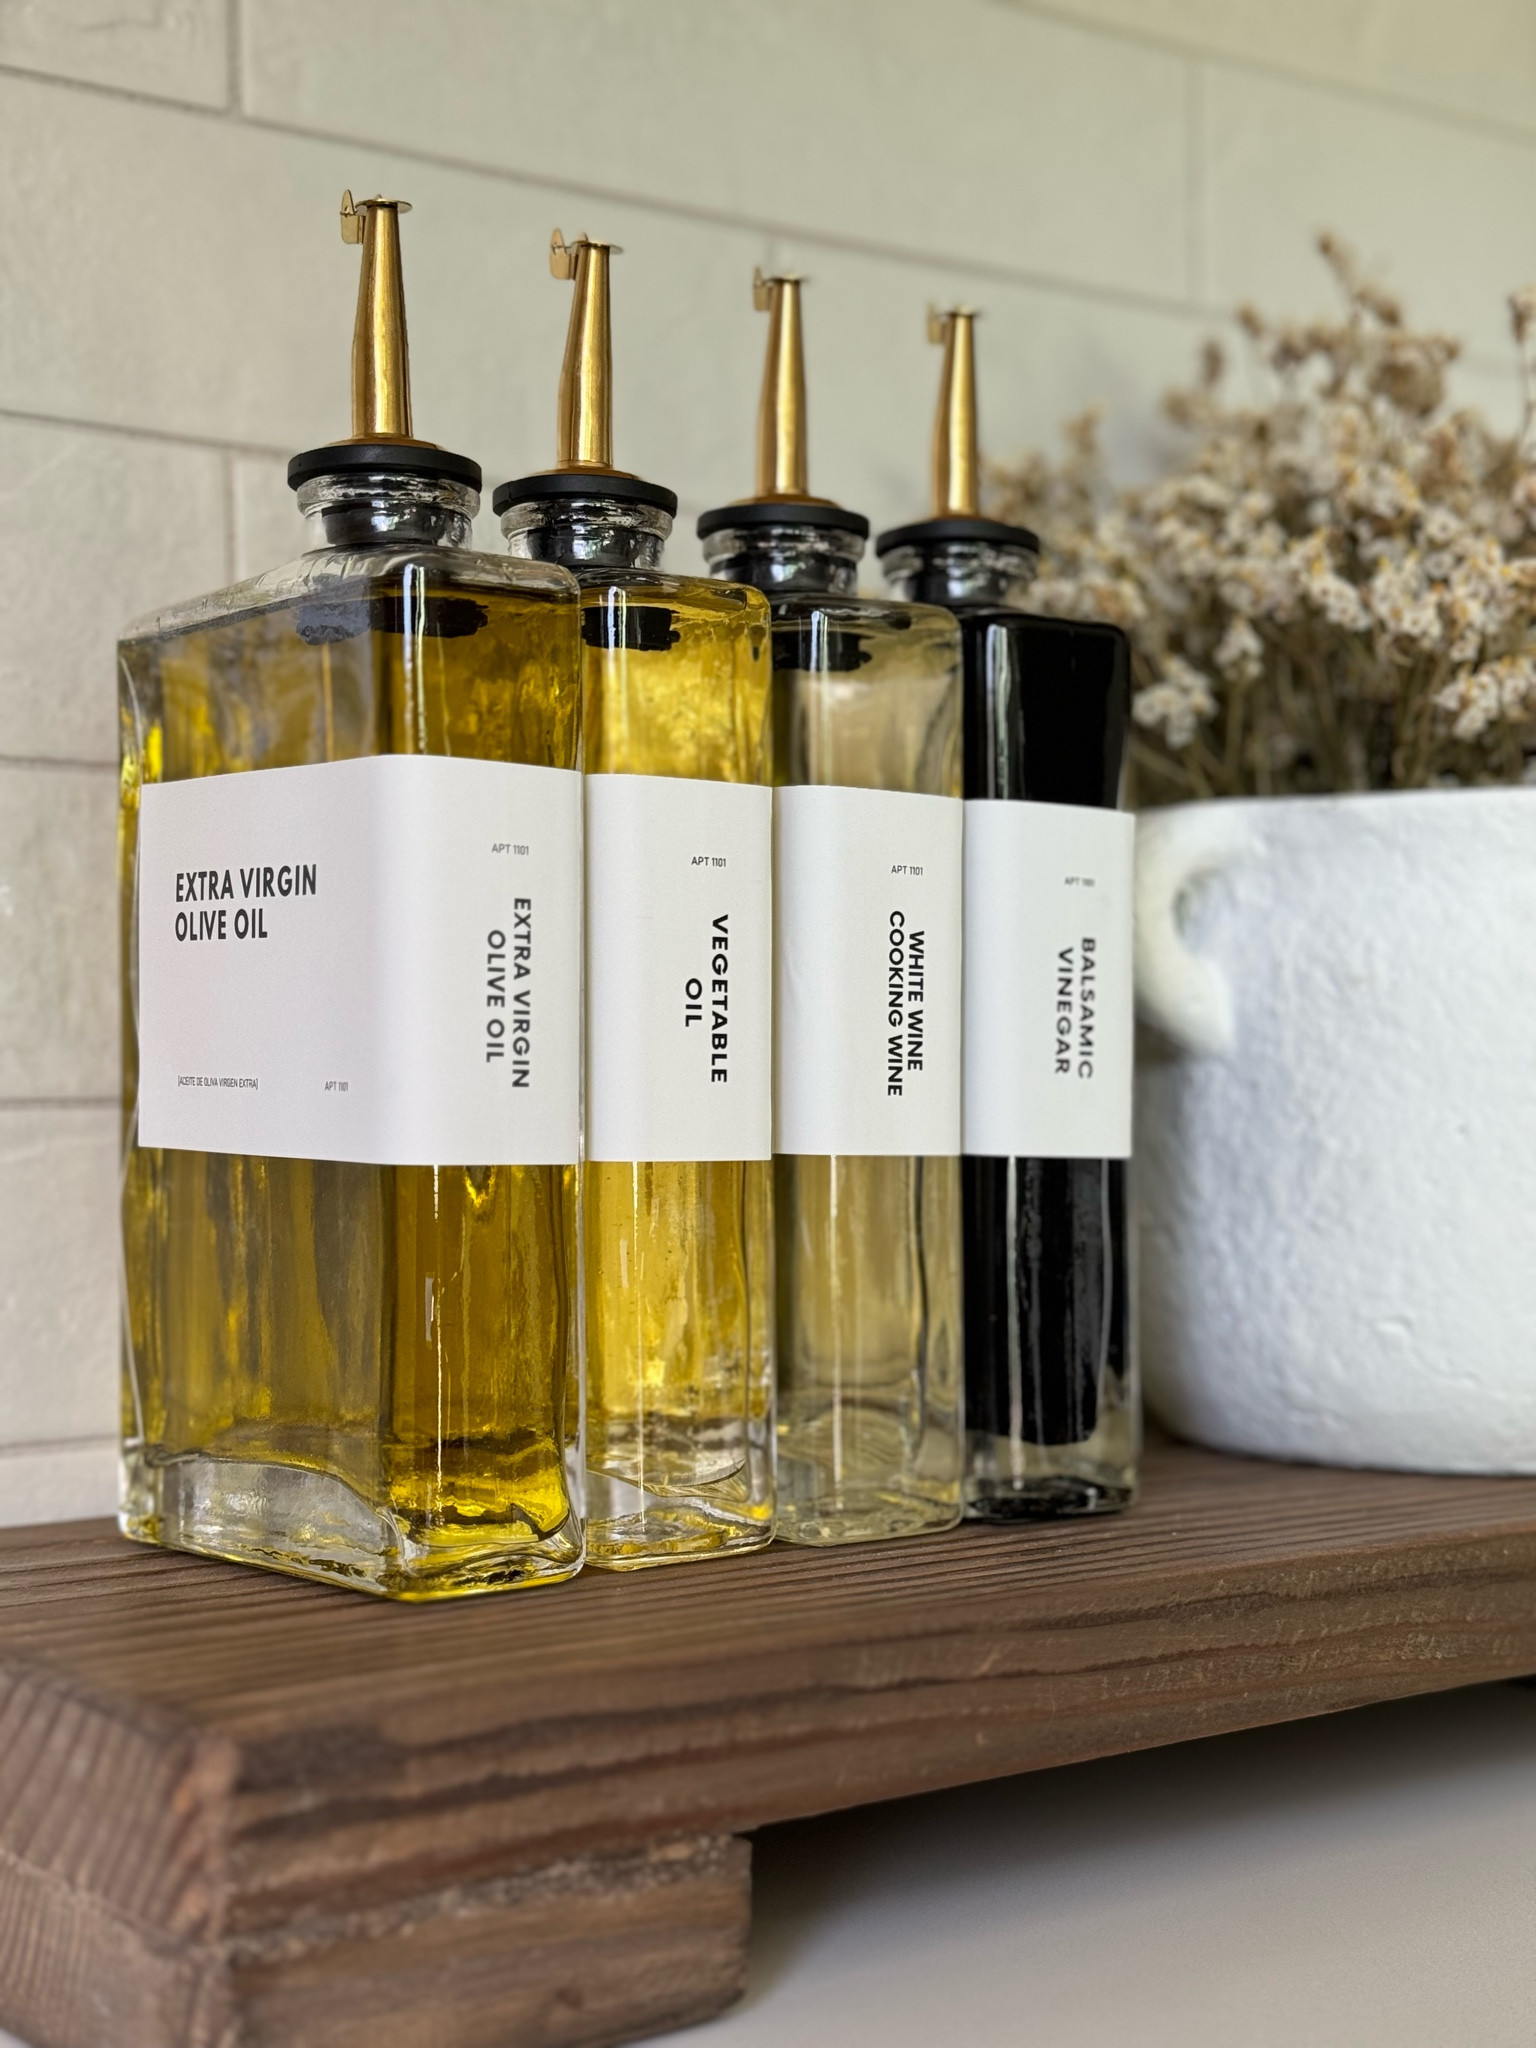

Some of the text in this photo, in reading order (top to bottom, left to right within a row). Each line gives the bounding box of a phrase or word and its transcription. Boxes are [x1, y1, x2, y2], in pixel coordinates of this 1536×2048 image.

[492, 843, 529, 855] APT 1101
[691, 856, 726, 867] APT 1101
[891, 865, 923, 876] APT 1101
[176, 864, 316, 902] EXTRA VIRGIN
[175, 908, 267, 942] OLIVE OIL
[486, 930, 506, 1063] OLIVE OIL
[512, 898, 531, 1087] EXTRA VIRGIN
[685, 978, 702, 1027] OIL
[711, 914, 728, 1082] VEGETABLE
[888, 911, 905, 1096] COOKING WINE
[908, 931, 924, 1070] WHITE WINE
[1055, 947, 1073, 1073] VINEGAR
[1078, 937, 1096, 1078] BALSAMIC
[197, 1077, 203, 1086] DE
[219, 1078, 238, 1087] VIRGEN
[239, 1078, 258, 1090] EXTRA]
[325, 1081, 337, 1091] APT
